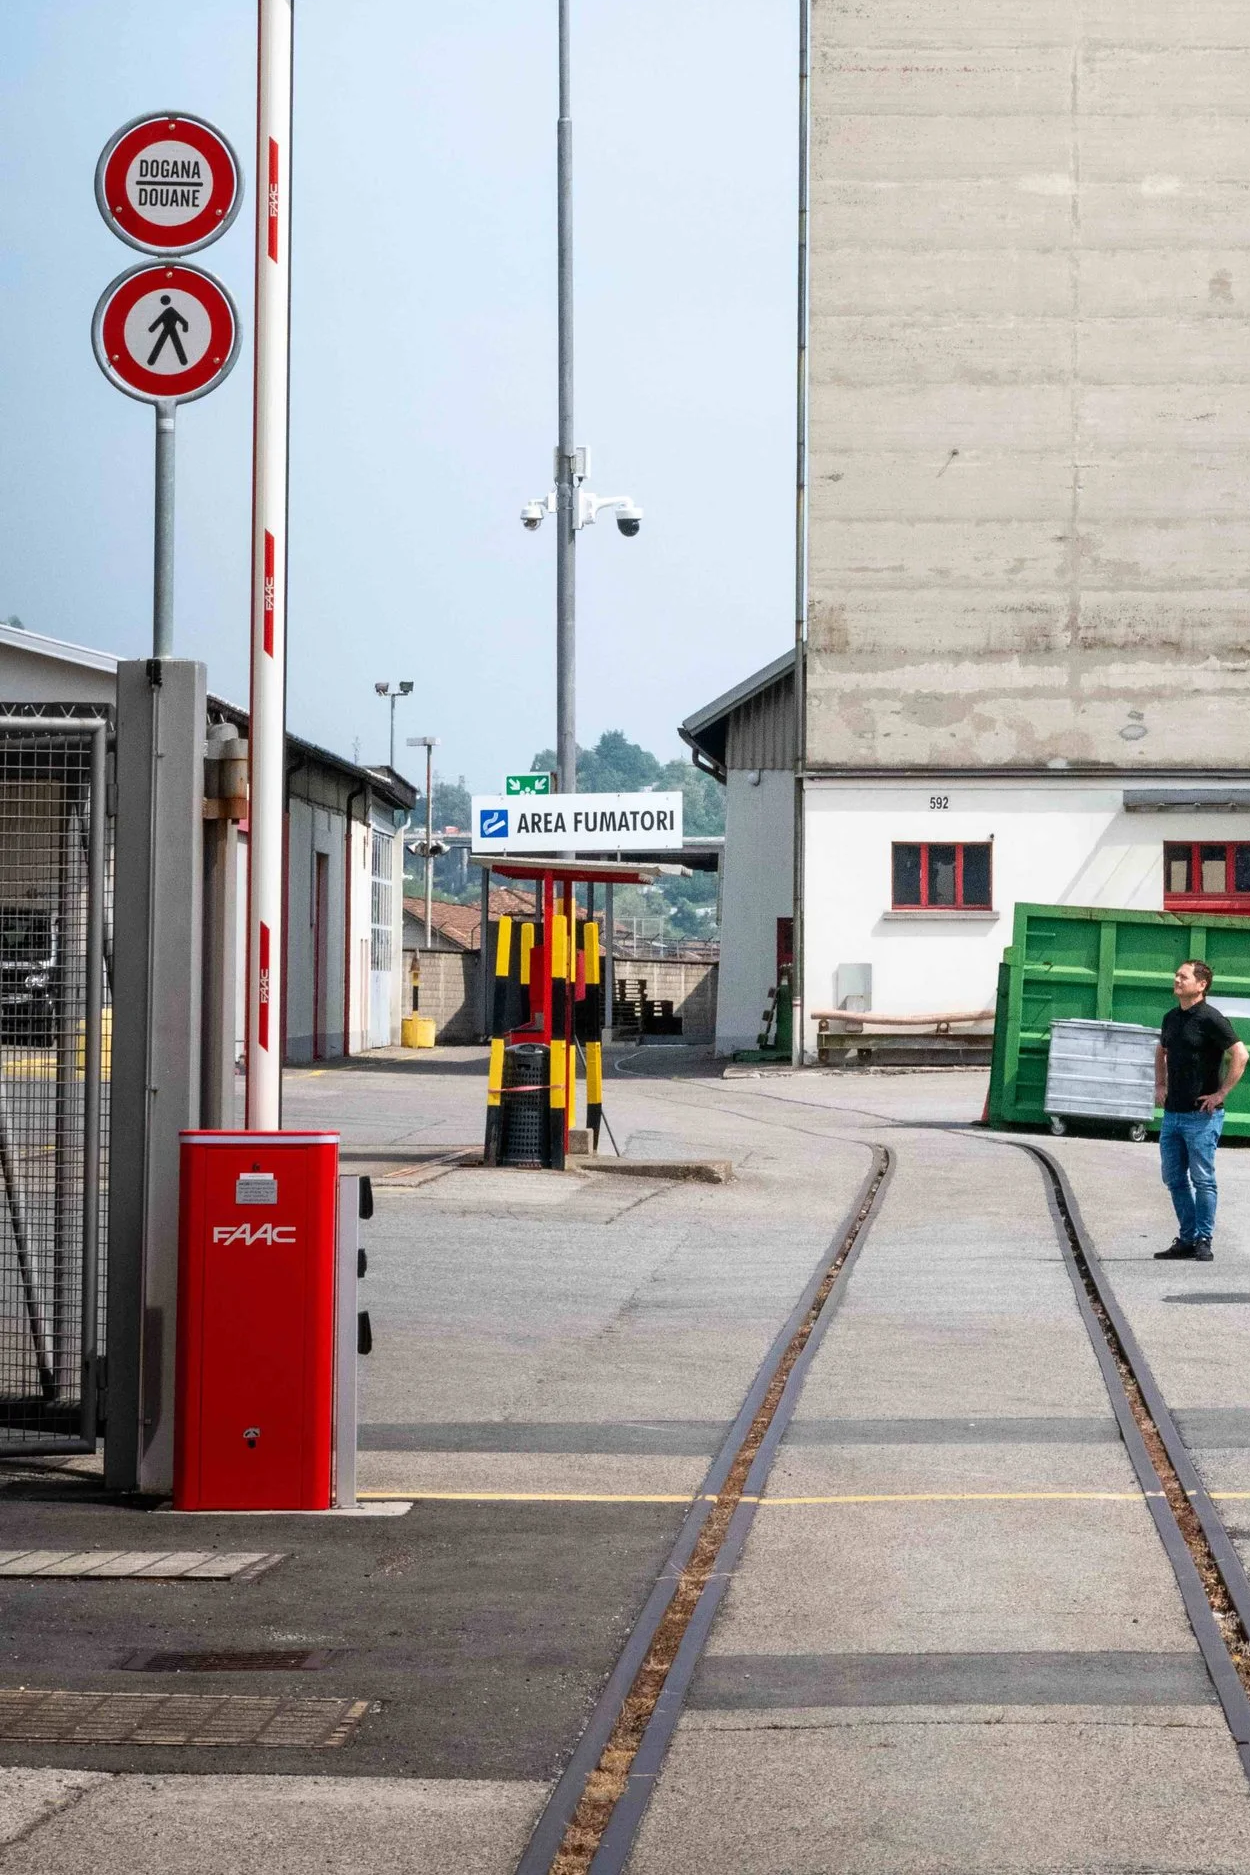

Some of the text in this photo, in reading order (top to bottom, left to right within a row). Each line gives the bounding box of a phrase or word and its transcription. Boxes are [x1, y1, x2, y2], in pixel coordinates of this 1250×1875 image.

[140, 159, 201, 179] DOGANA
[138, 188, 200, 207] DOUANE
[270, 184, 278, 217] FAAC
[266, 577, 274, 611] FAAC
[930, 796, 949, 810] 592
[517, 810, 675, 834] AREA FUMATORI
[260, 969, 268, 1003] FAAC
[213, 1223, 296, 1246] FAAC
